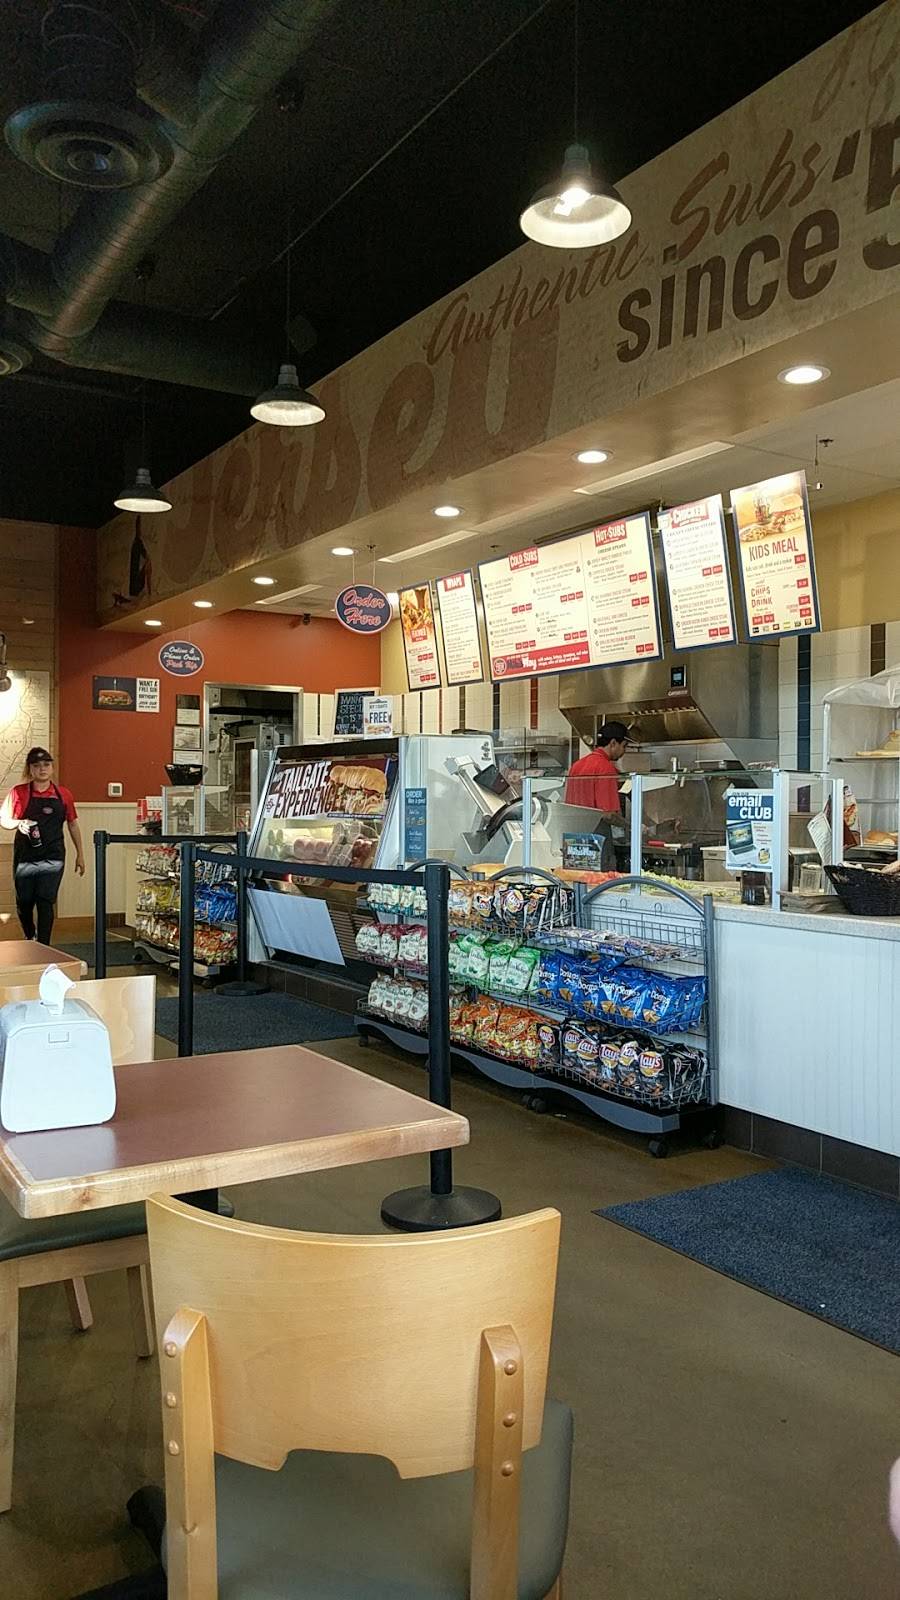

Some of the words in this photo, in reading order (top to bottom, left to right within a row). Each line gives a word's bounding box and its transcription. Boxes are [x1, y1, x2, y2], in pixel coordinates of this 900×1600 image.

[670, 128, 832, 264] Subs
[616, 208, 840, 364] since
[749, 543, 770, 561] KIDS
[771, 536, 799, 555] MEAL
[343, 589, 385, 609] Order
[343, 607, 382, 626] Here
[370, 712, 388, 724] FREE
[283, 761, 331, 792] TAILGATE
[728, 795, 762, 807] email
[739, 807, 772, 820] CLUB
[640, 1054, 661, 1069] Lay's
